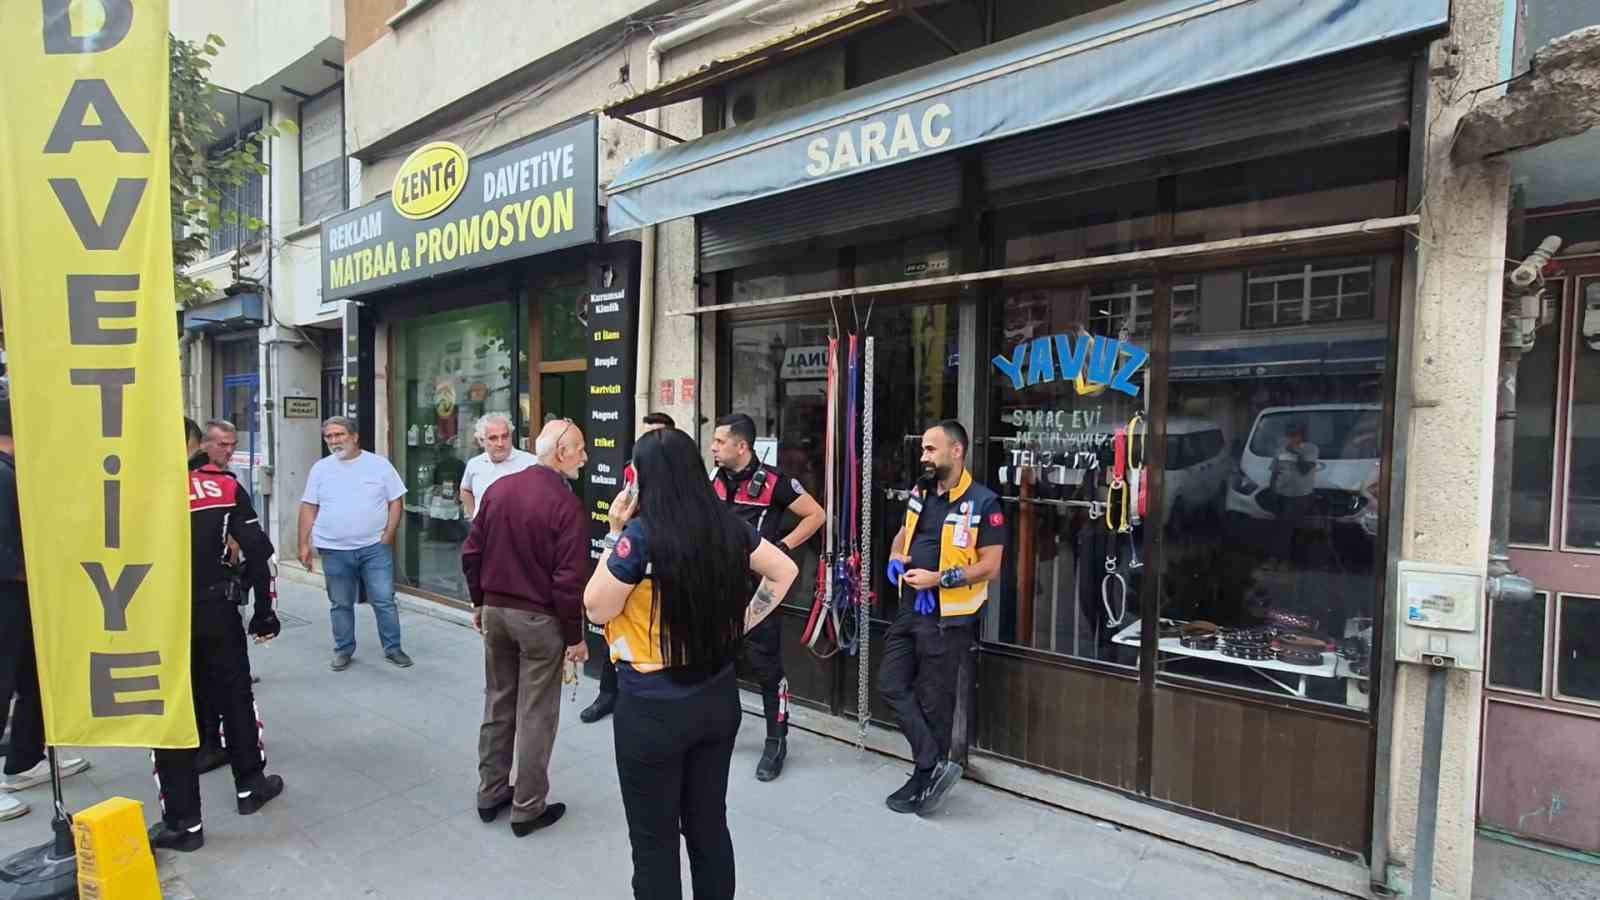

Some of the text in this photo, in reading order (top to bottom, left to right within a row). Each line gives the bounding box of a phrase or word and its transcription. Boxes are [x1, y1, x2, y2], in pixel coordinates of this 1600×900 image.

[806, 103, 952, 177] SARAC
[400, 157, 457, 205] ZENTA
[329, 211, 383, 252] REKLAM
[329, 187, 574, 289] MATBAA & PROMOSYON
[991, 333, 1150, 398] YAVUZ
[592, 410, 619, 421] Magnet
[1011, 409, 1065, 432] SARAÇ
[594, 437, 615, 448] Etiket
[597, 463, 611, 473] Oto
